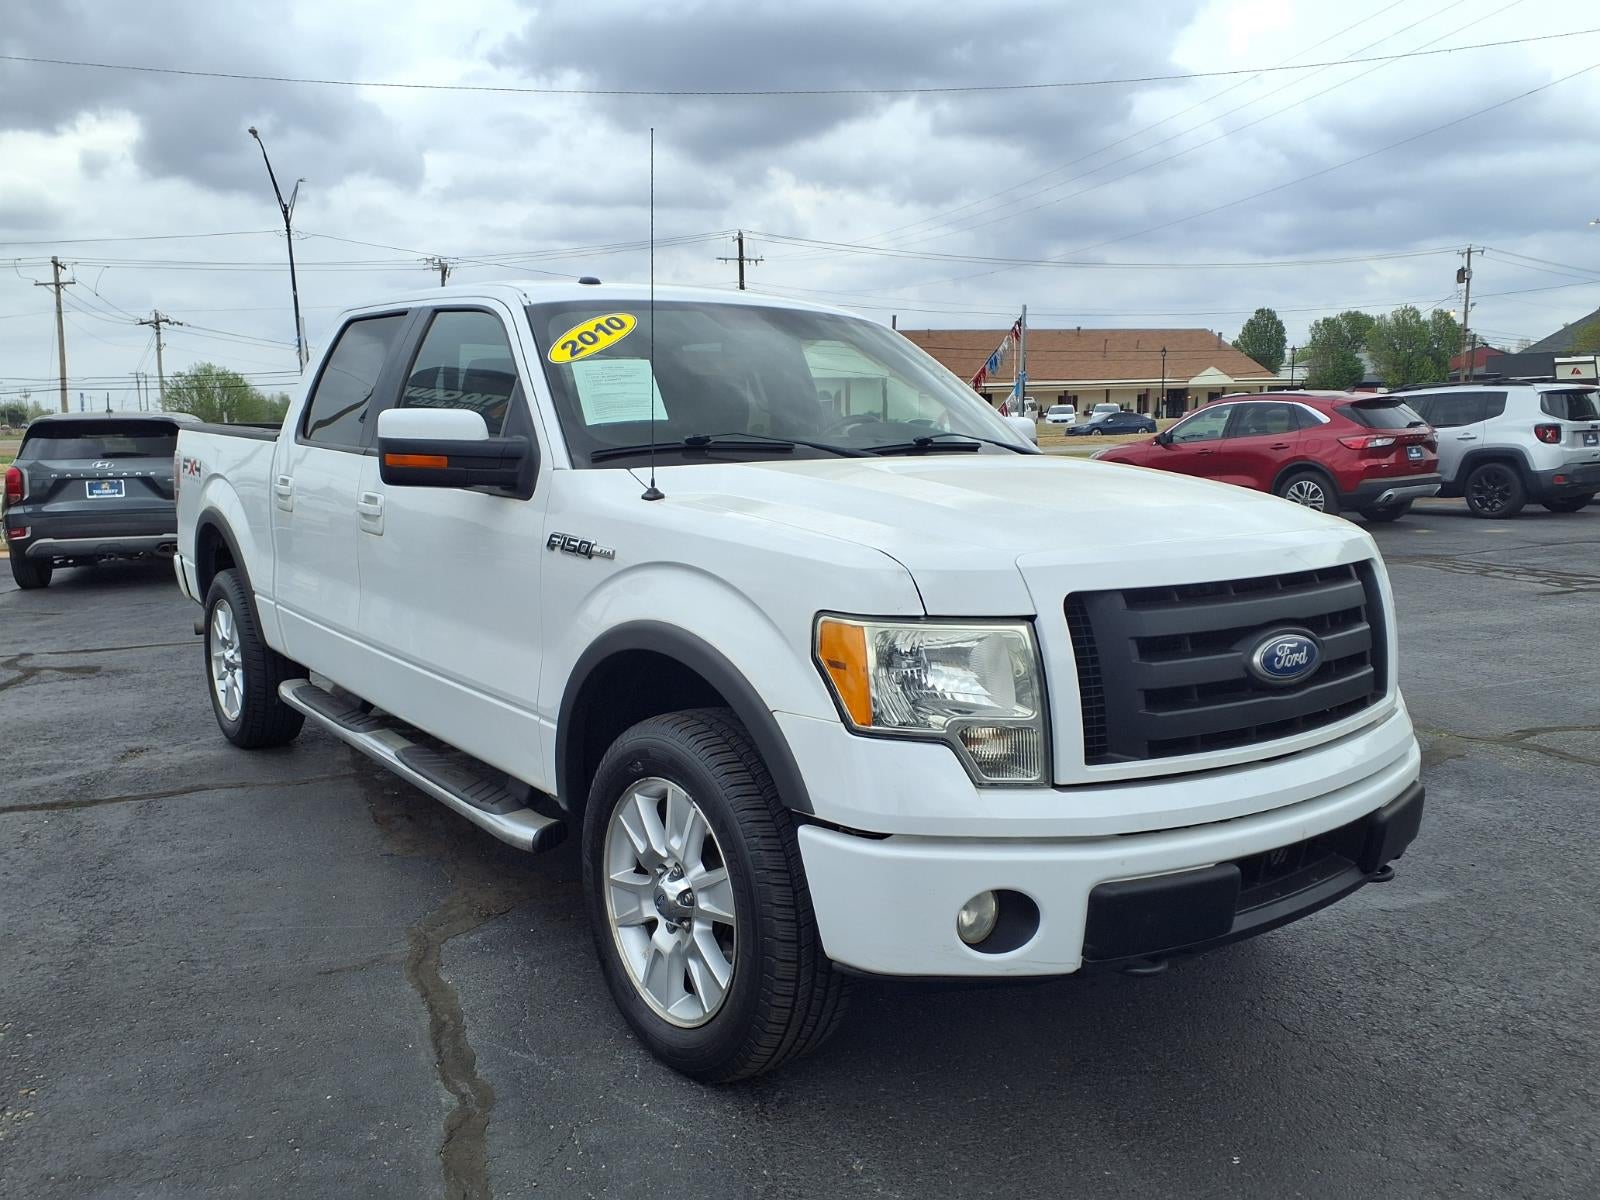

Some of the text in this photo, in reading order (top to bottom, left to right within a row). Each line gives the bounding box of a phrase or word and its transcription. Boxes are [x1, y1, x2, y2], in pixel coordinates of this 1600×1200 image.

[561, 316, 627, 358] 2010
[182, 457, 202, 478] FX4
[1274, 642, 1308, 669] Ford
